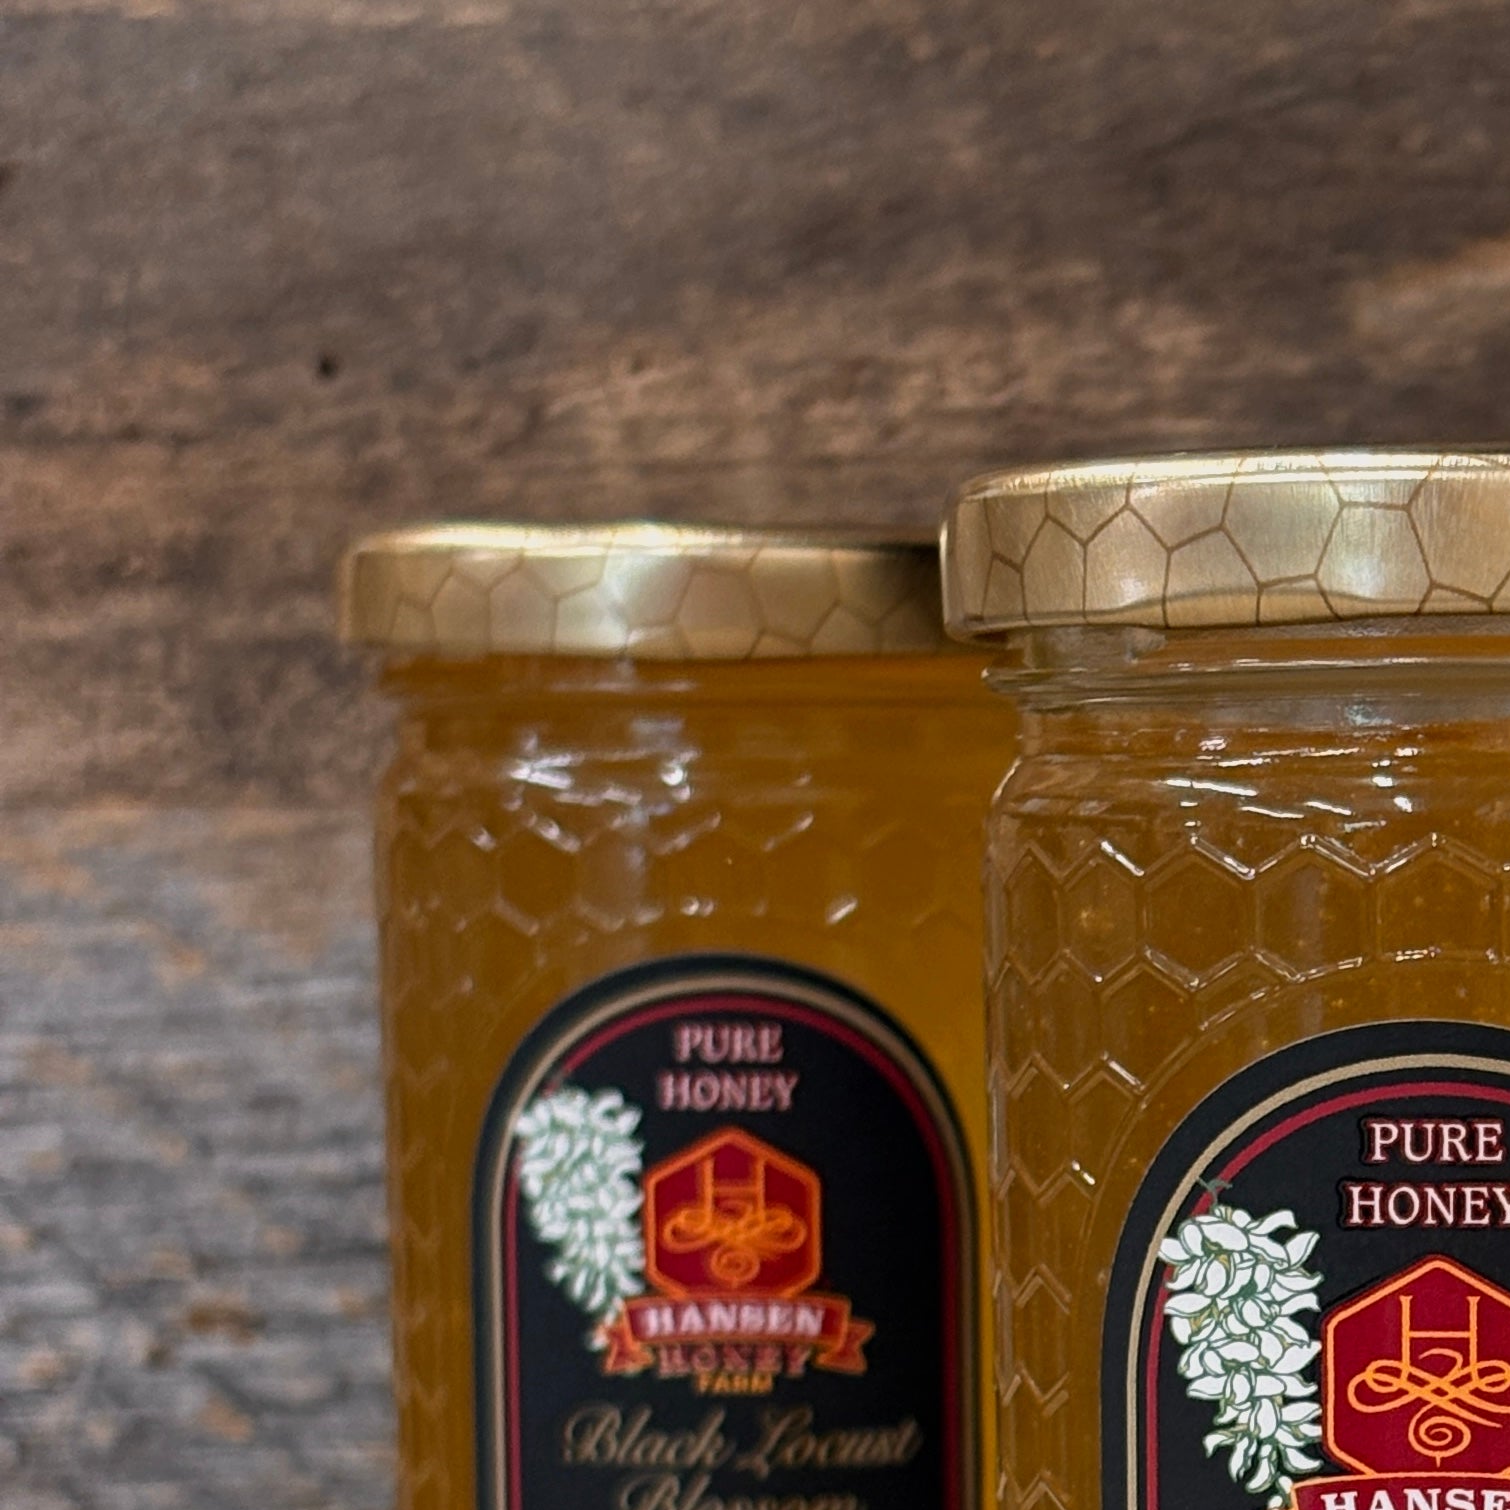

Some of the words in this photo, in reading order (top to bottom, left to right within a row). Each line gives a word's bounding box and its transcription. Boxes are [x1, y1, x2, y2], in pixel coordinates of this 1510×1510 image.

[673, 1023, 785, 1063] PURE
[658, 1071, 799, 1111] HONEY
[1371, 1122, 1504, 1164] PURE
[644, 1301, 826, 1337] HANSEN
[656, 1345, 812, 1375] HONEY
[696, 1373, 774, 1393] FARM
